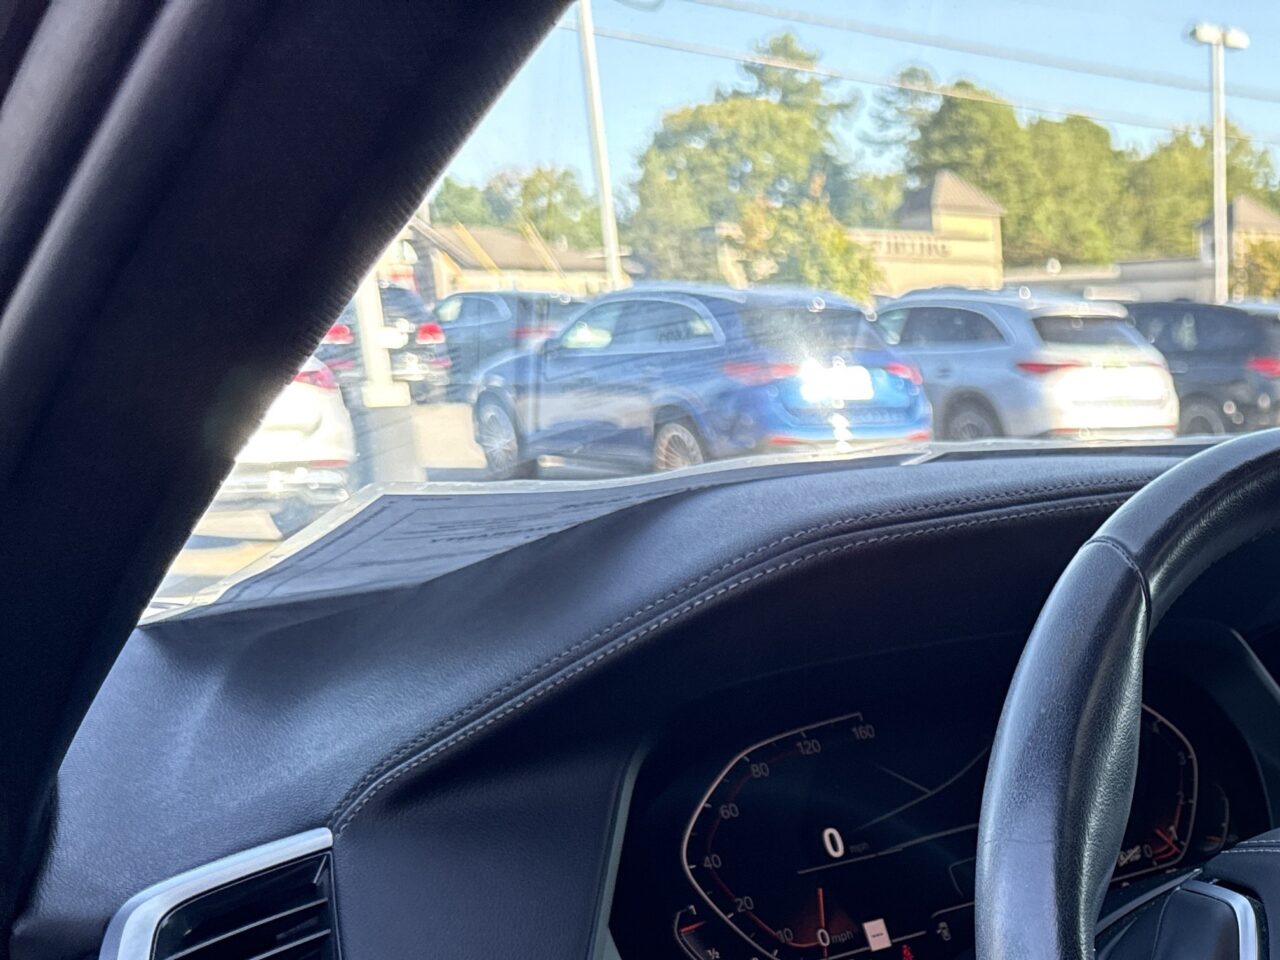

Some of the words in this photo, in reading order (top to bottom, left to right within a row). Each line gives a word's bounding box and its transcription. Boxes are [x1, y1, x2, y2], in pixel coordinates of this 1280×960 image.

[851, 724, 875, 740] 160
[796, 738, 822, 756] 120
[750, 762, 770, 779] 80
[719, 803, 740, 820] 60
[821, 826, 845, 858] 0
[703, 853, 723, 870] 40
[735, 896, 755, 913] 20
[779, 928, 794, 944] 10
[817, 928, 831, 946] 0
[831, 931, 854, 946] mph
